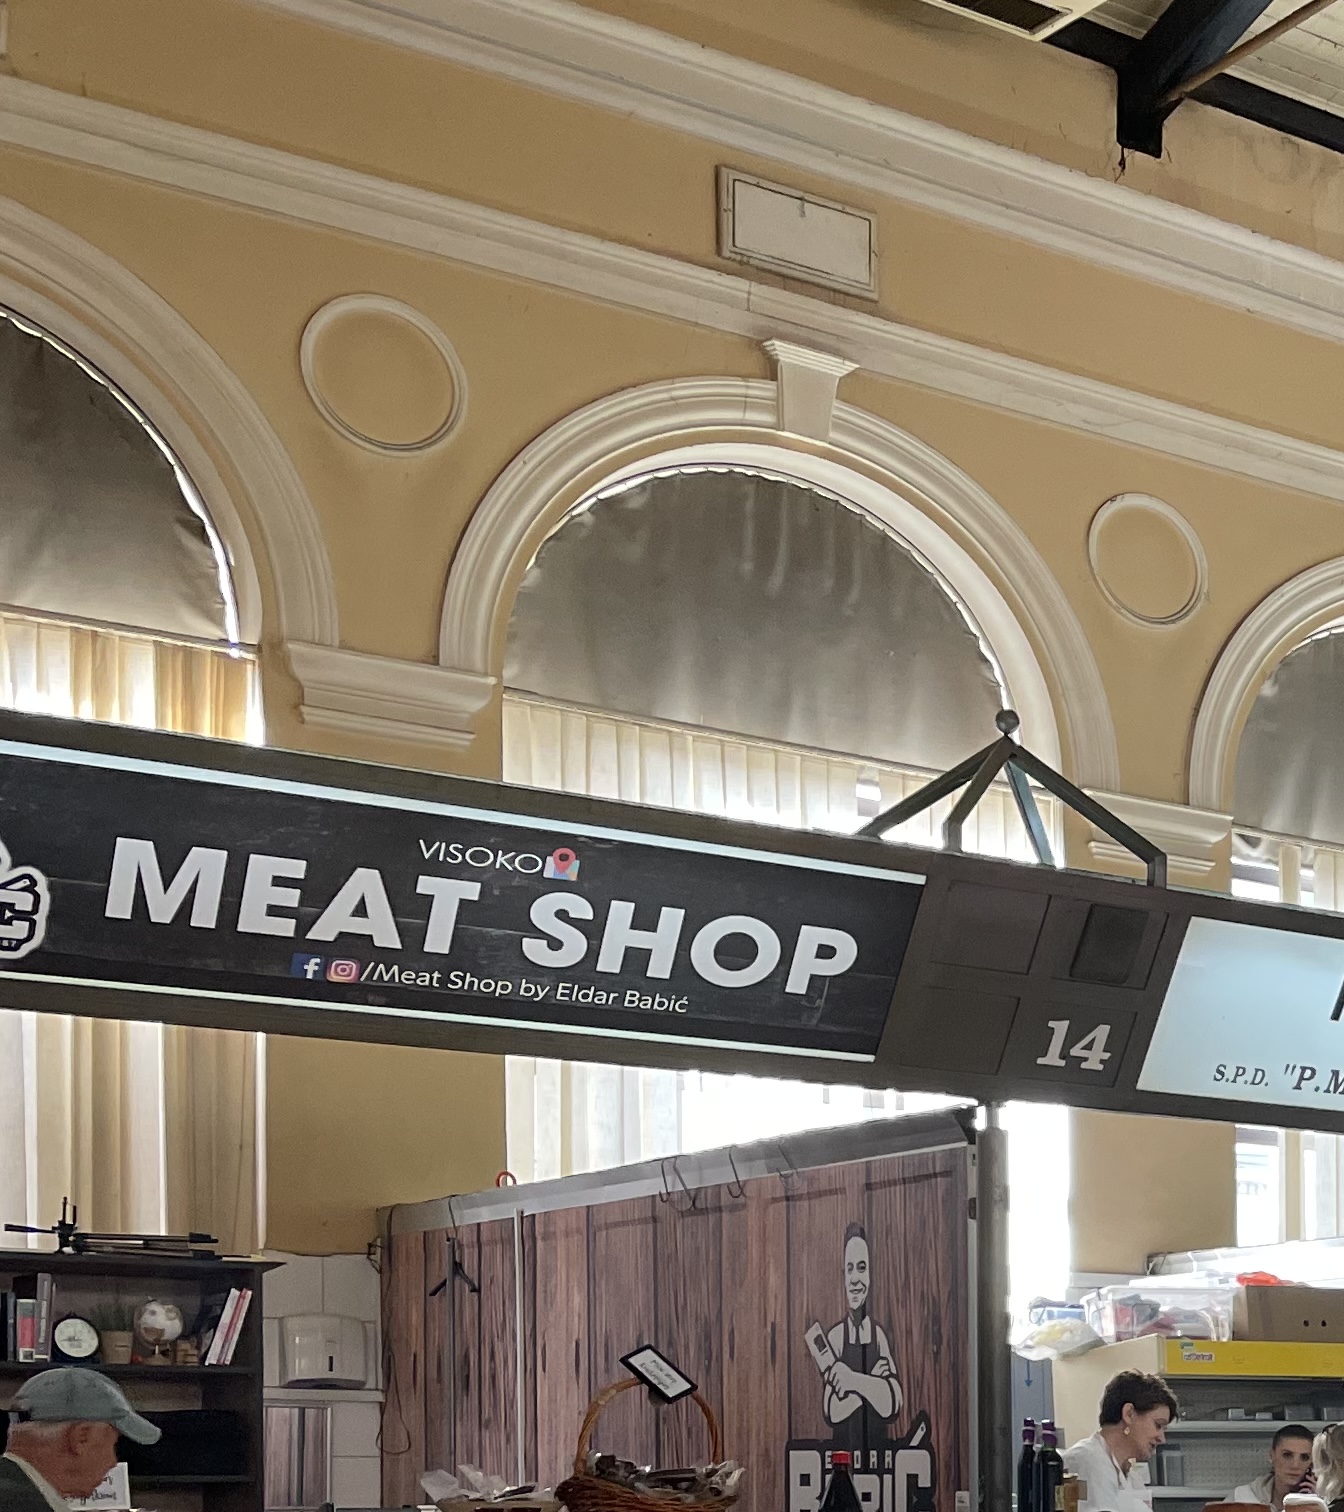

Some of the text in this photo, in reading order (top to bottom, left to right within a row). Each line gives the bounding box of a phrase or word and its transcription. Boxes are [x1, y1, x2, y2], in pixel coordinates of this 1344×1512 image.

[418, 838, 544, 876] VISOKO
[104, 836, 482, 956] MEAT
[521, 890, 859, 997] SHOP
[359, 961, 443, 989] /Meat
[446, 970, 514, 998] Shop
[519, 978, 551, 1003] by
[556, 982, 620, 1008] Eldar
[623, 989, 690, 1014] Babić
[1035, 1018, 1113, 1072] 14
[1213, 1063, 1269, 1087] S.P.D.
